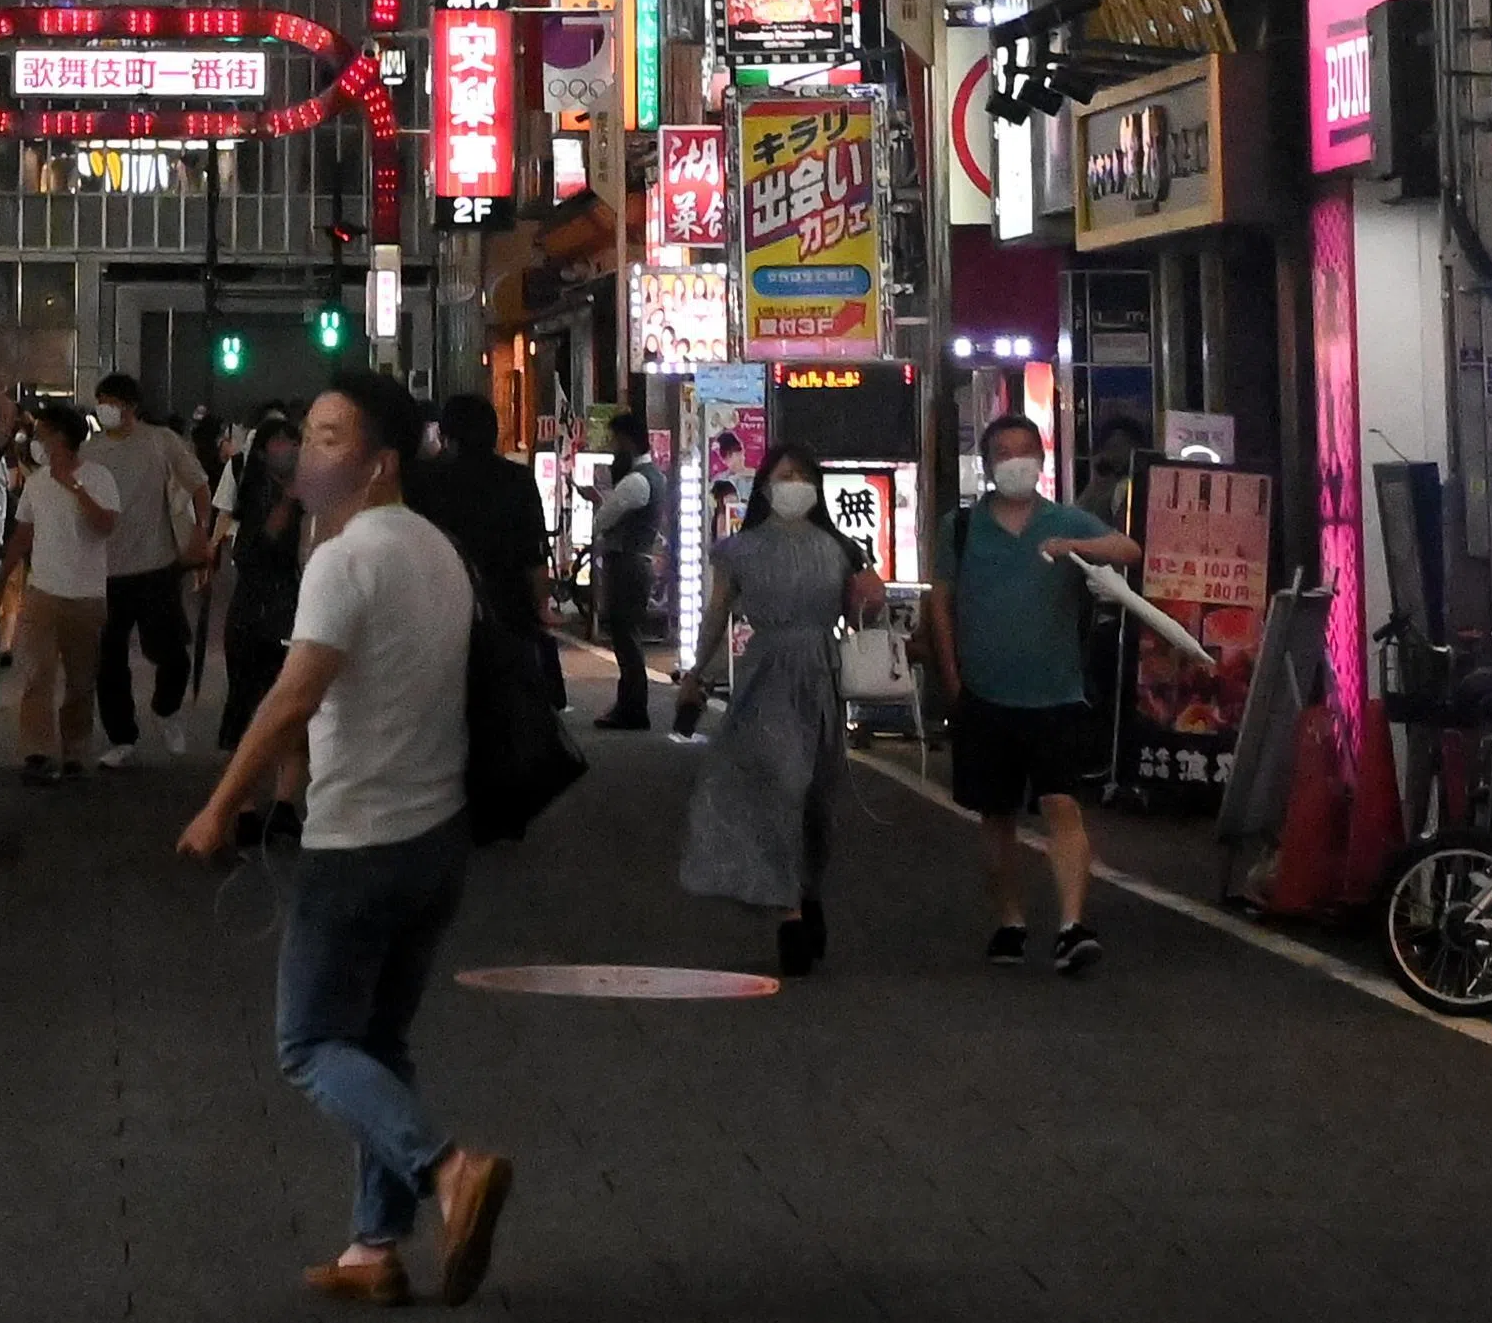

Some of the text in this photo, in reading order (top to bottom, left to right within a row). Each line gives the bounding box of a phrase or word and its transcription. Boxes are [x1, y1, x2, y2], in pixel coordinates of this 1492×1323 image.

[22, 57, 260, 90] 歌舞伎町一番街
[752, 102, 852, 166] キラリ
[452, 197, 492, 223] 2F
[751, 140, 866, 238] 出会い
[797, 185, 873, 260] カフェ
